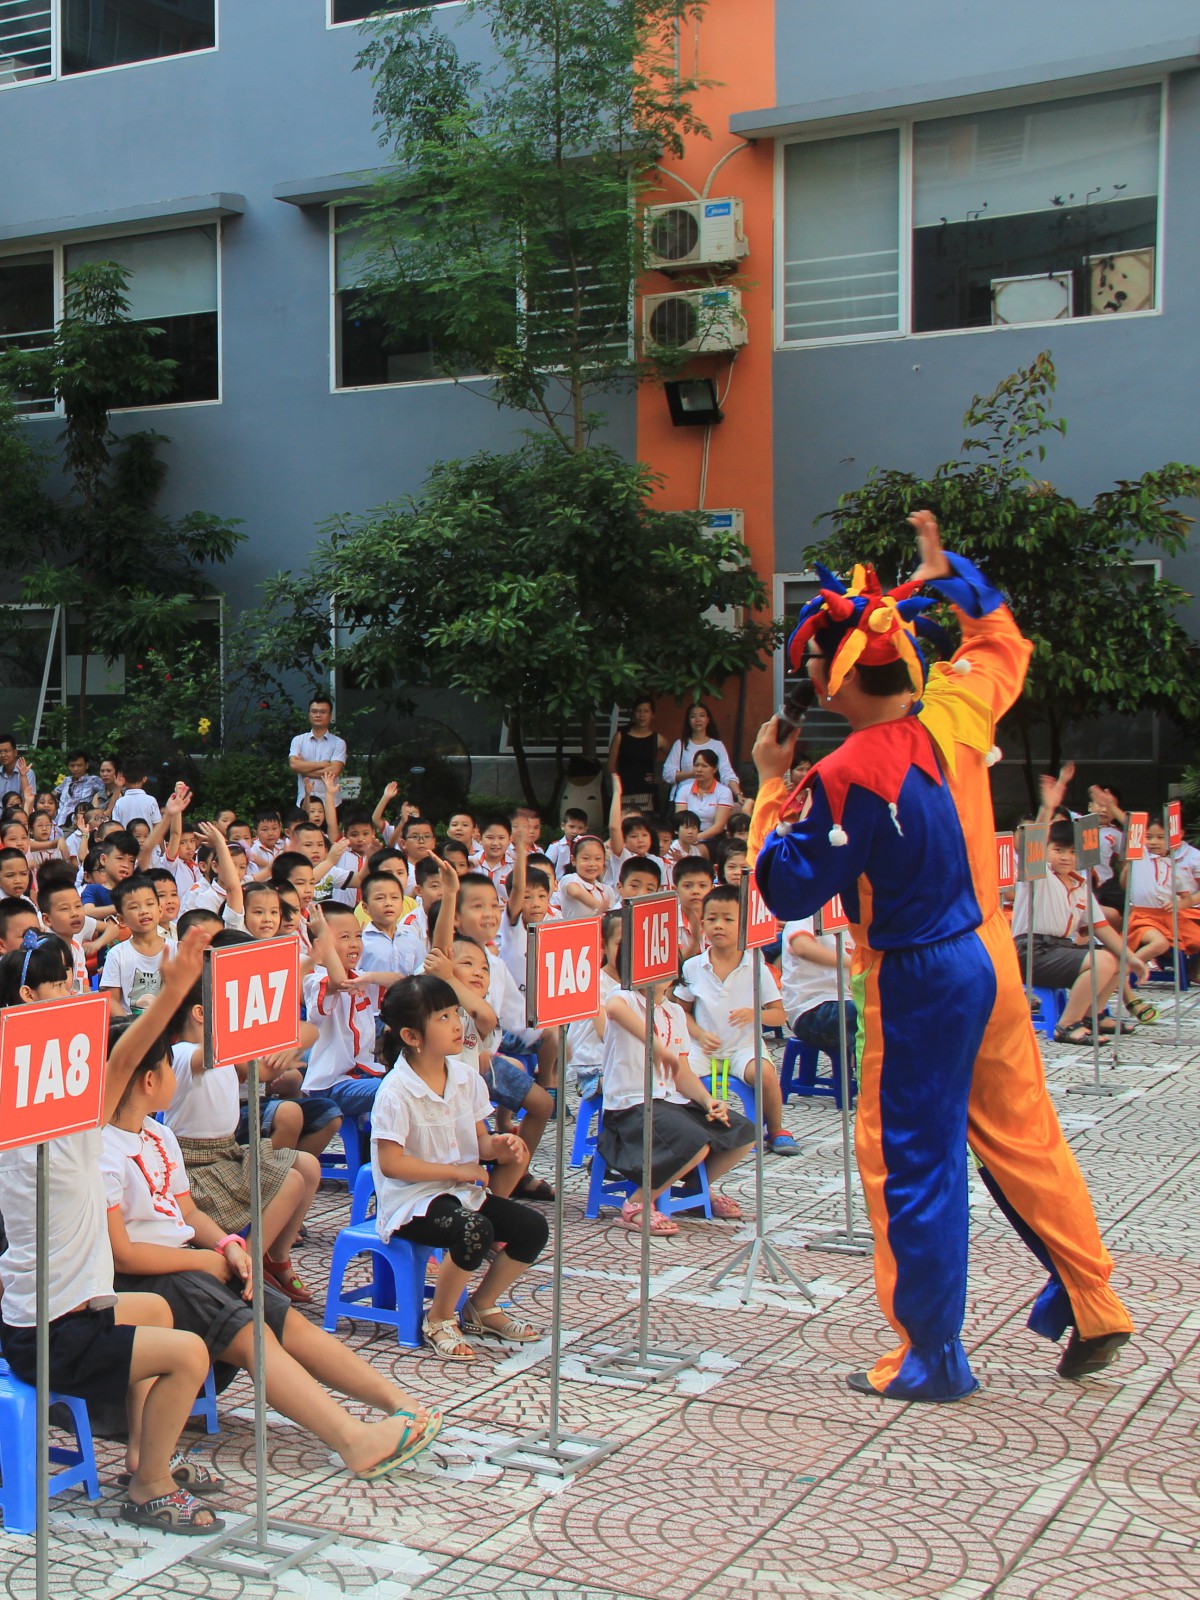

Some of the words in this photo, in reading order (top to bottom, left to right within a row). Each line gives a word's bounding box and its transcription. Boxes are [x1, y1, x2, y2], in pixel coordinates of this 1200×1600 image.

[1082, 828, 1099, 851] 3A3
[1129, 823, 1143, 849] 3A2
[1169, 814, 1178, 839] 3A1
[999, 844, 1011, 880] 1A1
[1026, 841, 1044, 863] 3A4
[642, 912, 669, 967] 1A5
[545, 945, 591, 998] 1A6
[225, 969, 289, 1032] 1A7
[14, 1033, 91, 1109] 1A8
